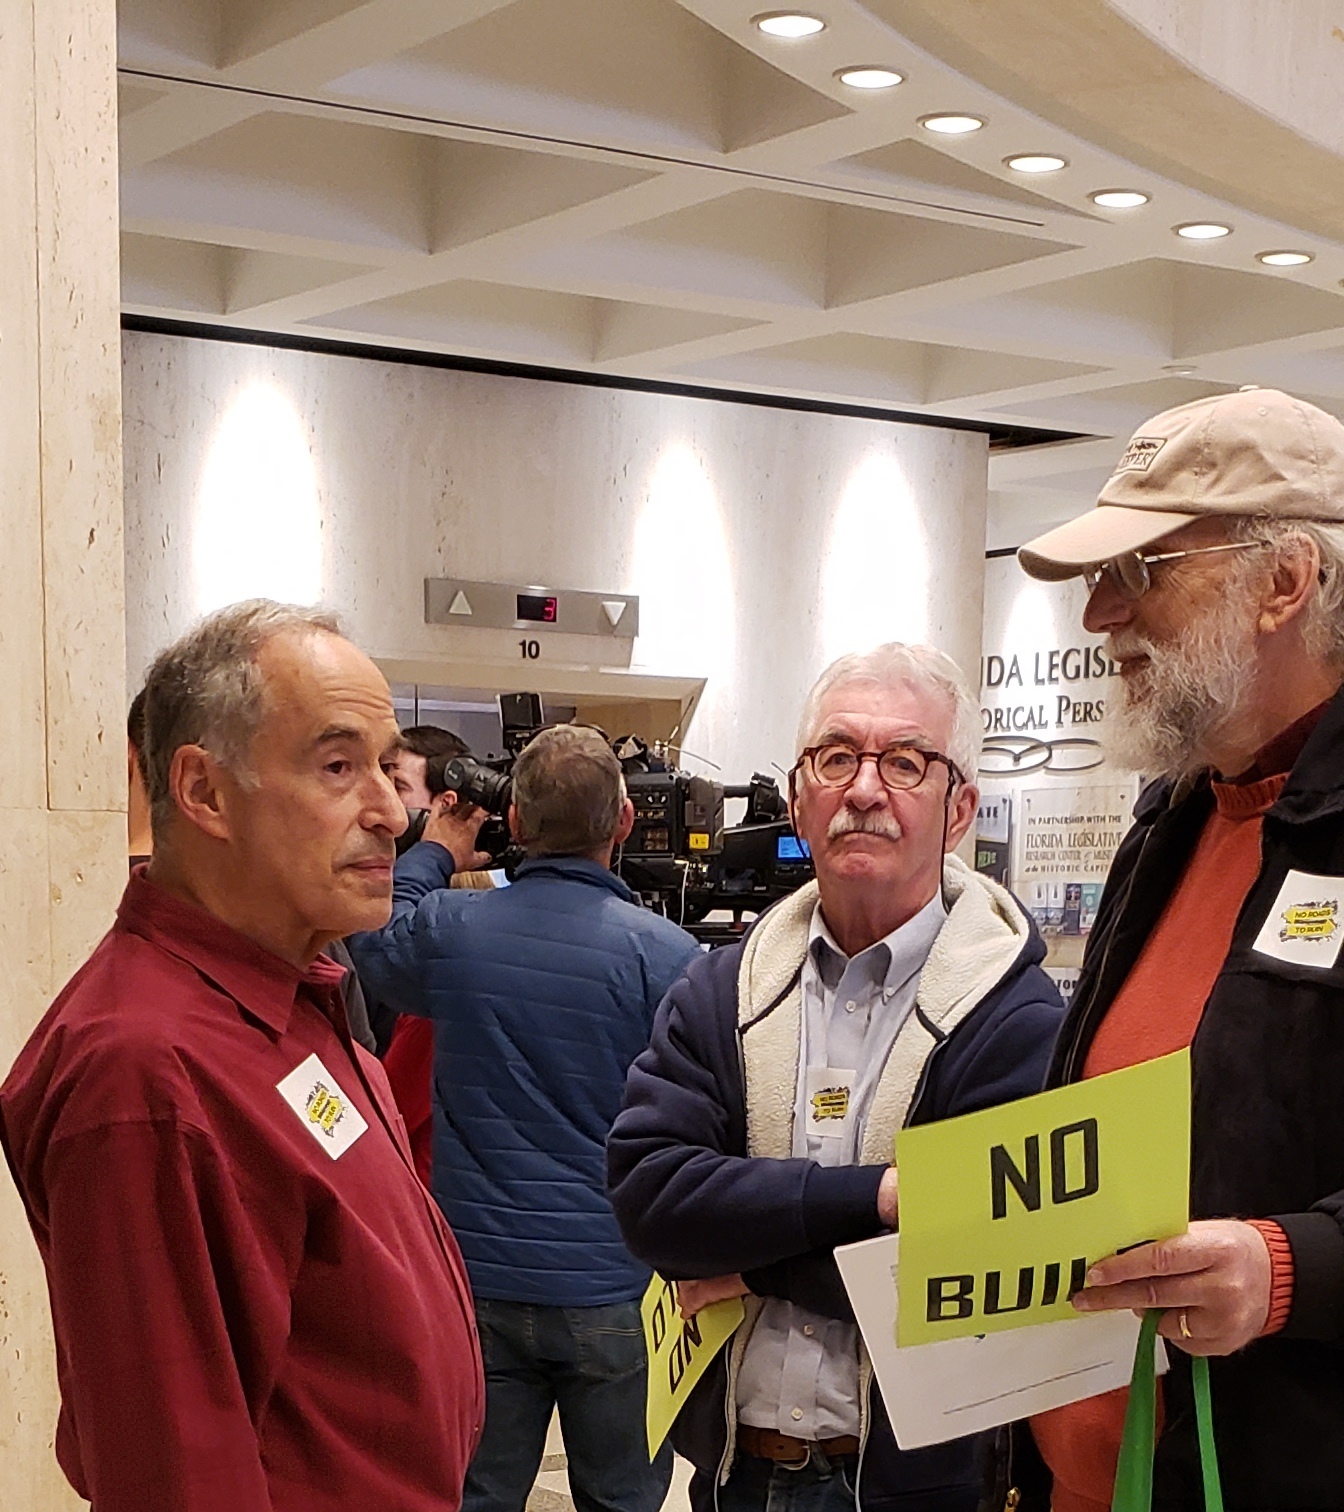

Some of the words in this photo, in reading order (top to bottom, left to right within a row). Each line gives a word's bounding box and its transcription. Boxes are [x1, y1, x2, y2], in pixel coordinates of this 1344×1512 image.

[543, 598, 556, 621] 3
[518, 638, 541, 660] 10
[1026, 833, 1064, 848] FLORIDA
[990, 1117, 1099, 1220] NO
